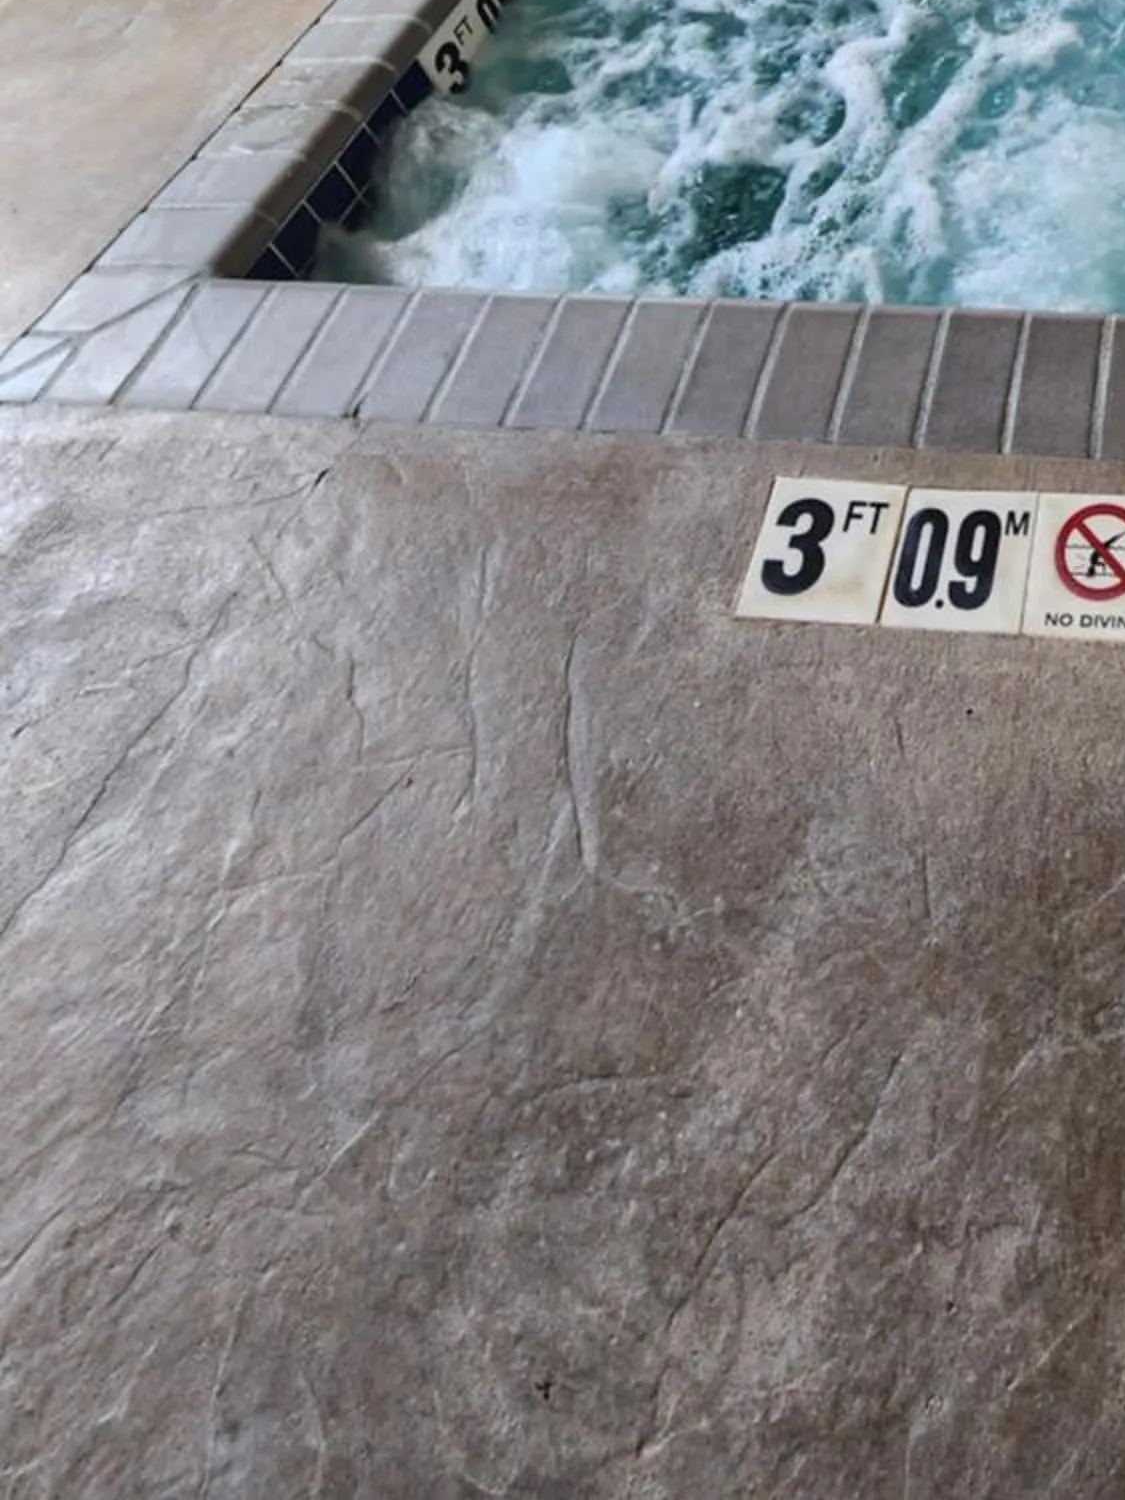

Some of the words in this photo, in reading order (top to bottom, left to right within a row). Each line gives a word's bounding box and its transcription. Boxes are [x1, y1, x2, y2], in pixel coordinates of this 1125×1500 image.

[435, 41, 470, 94] 3
[453, 14, 474, 46] FT
[761, 498, 835, 596] 3
[842, 501, 890, 535] FT
[893, 507, 1001, 611] 0.9
[1004, 511, 1031, 537] M
[1044, 612, 1075, 628] NO
